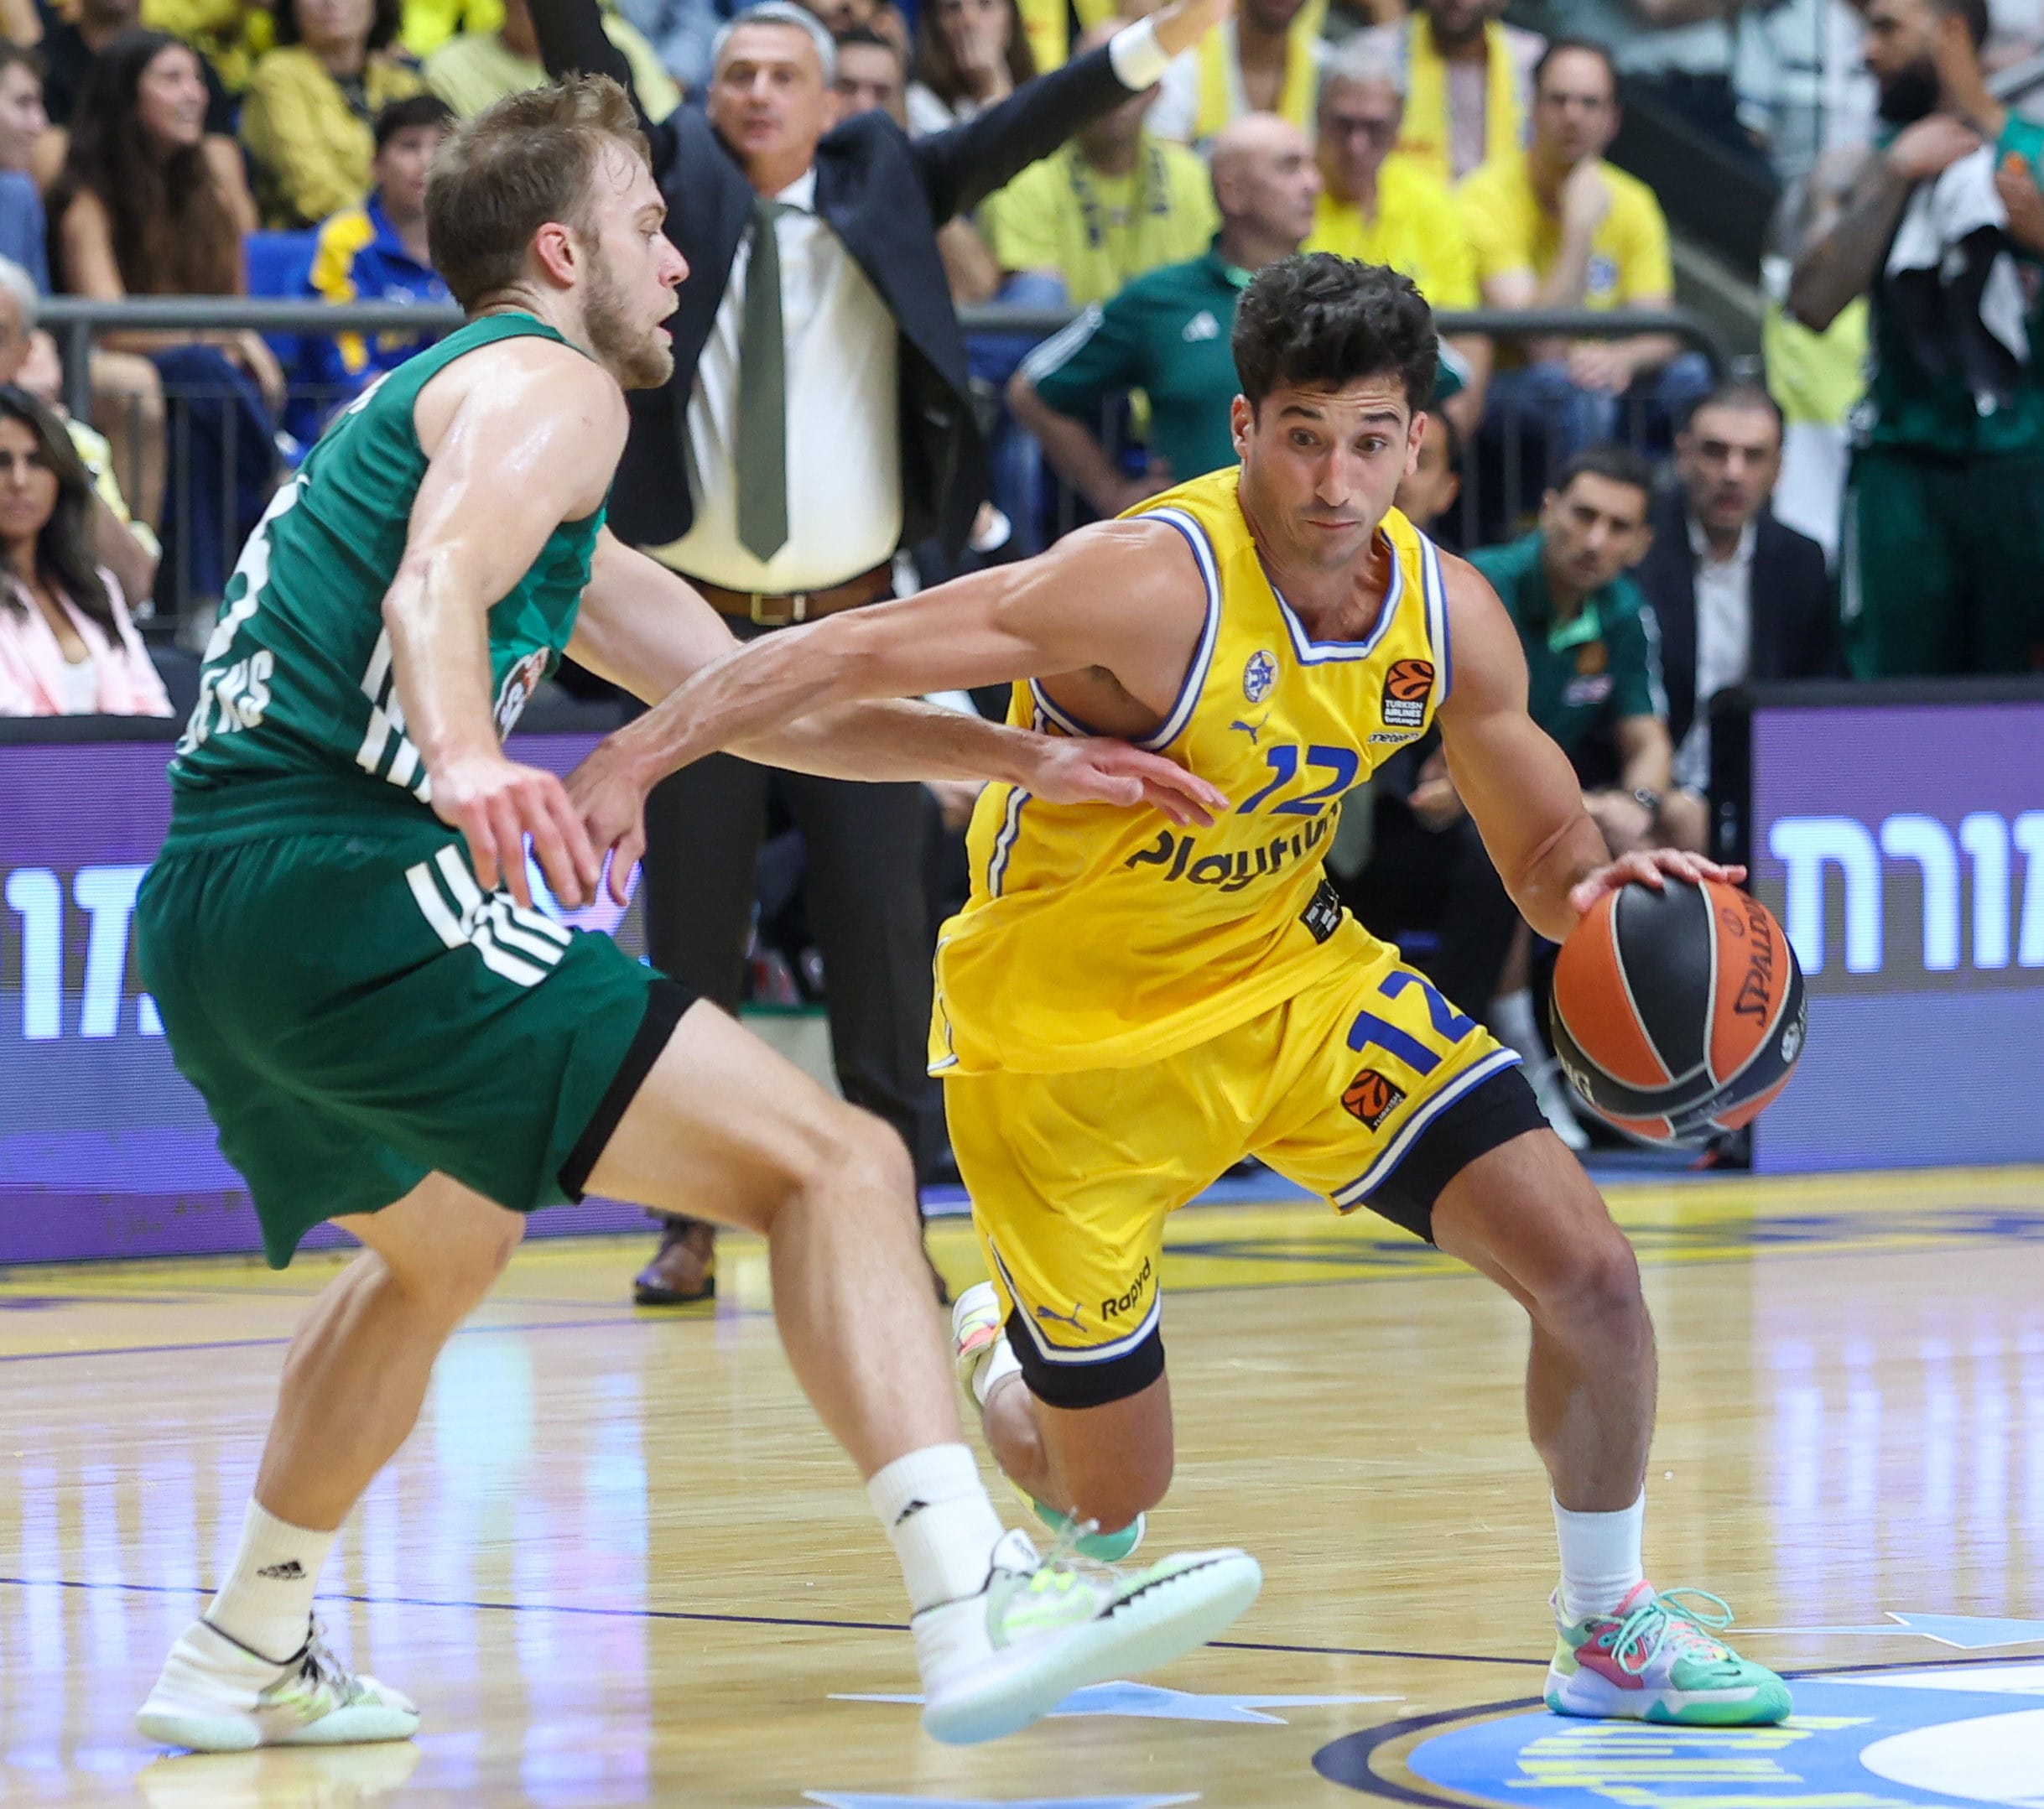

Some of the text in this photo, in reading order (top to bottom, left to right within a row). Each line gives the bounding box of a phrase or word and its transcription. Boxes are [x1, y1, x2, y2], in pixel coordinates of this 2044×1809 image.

[1385, 699, 1423, 710] TURKISH
[1385, 708, 1422, 718] AIRLINES
[1235, 745, 1359, 815] 12
[1346, 970, 1476, 1077] 12
[1100, 1255, 1152, 1321] Rapyd
